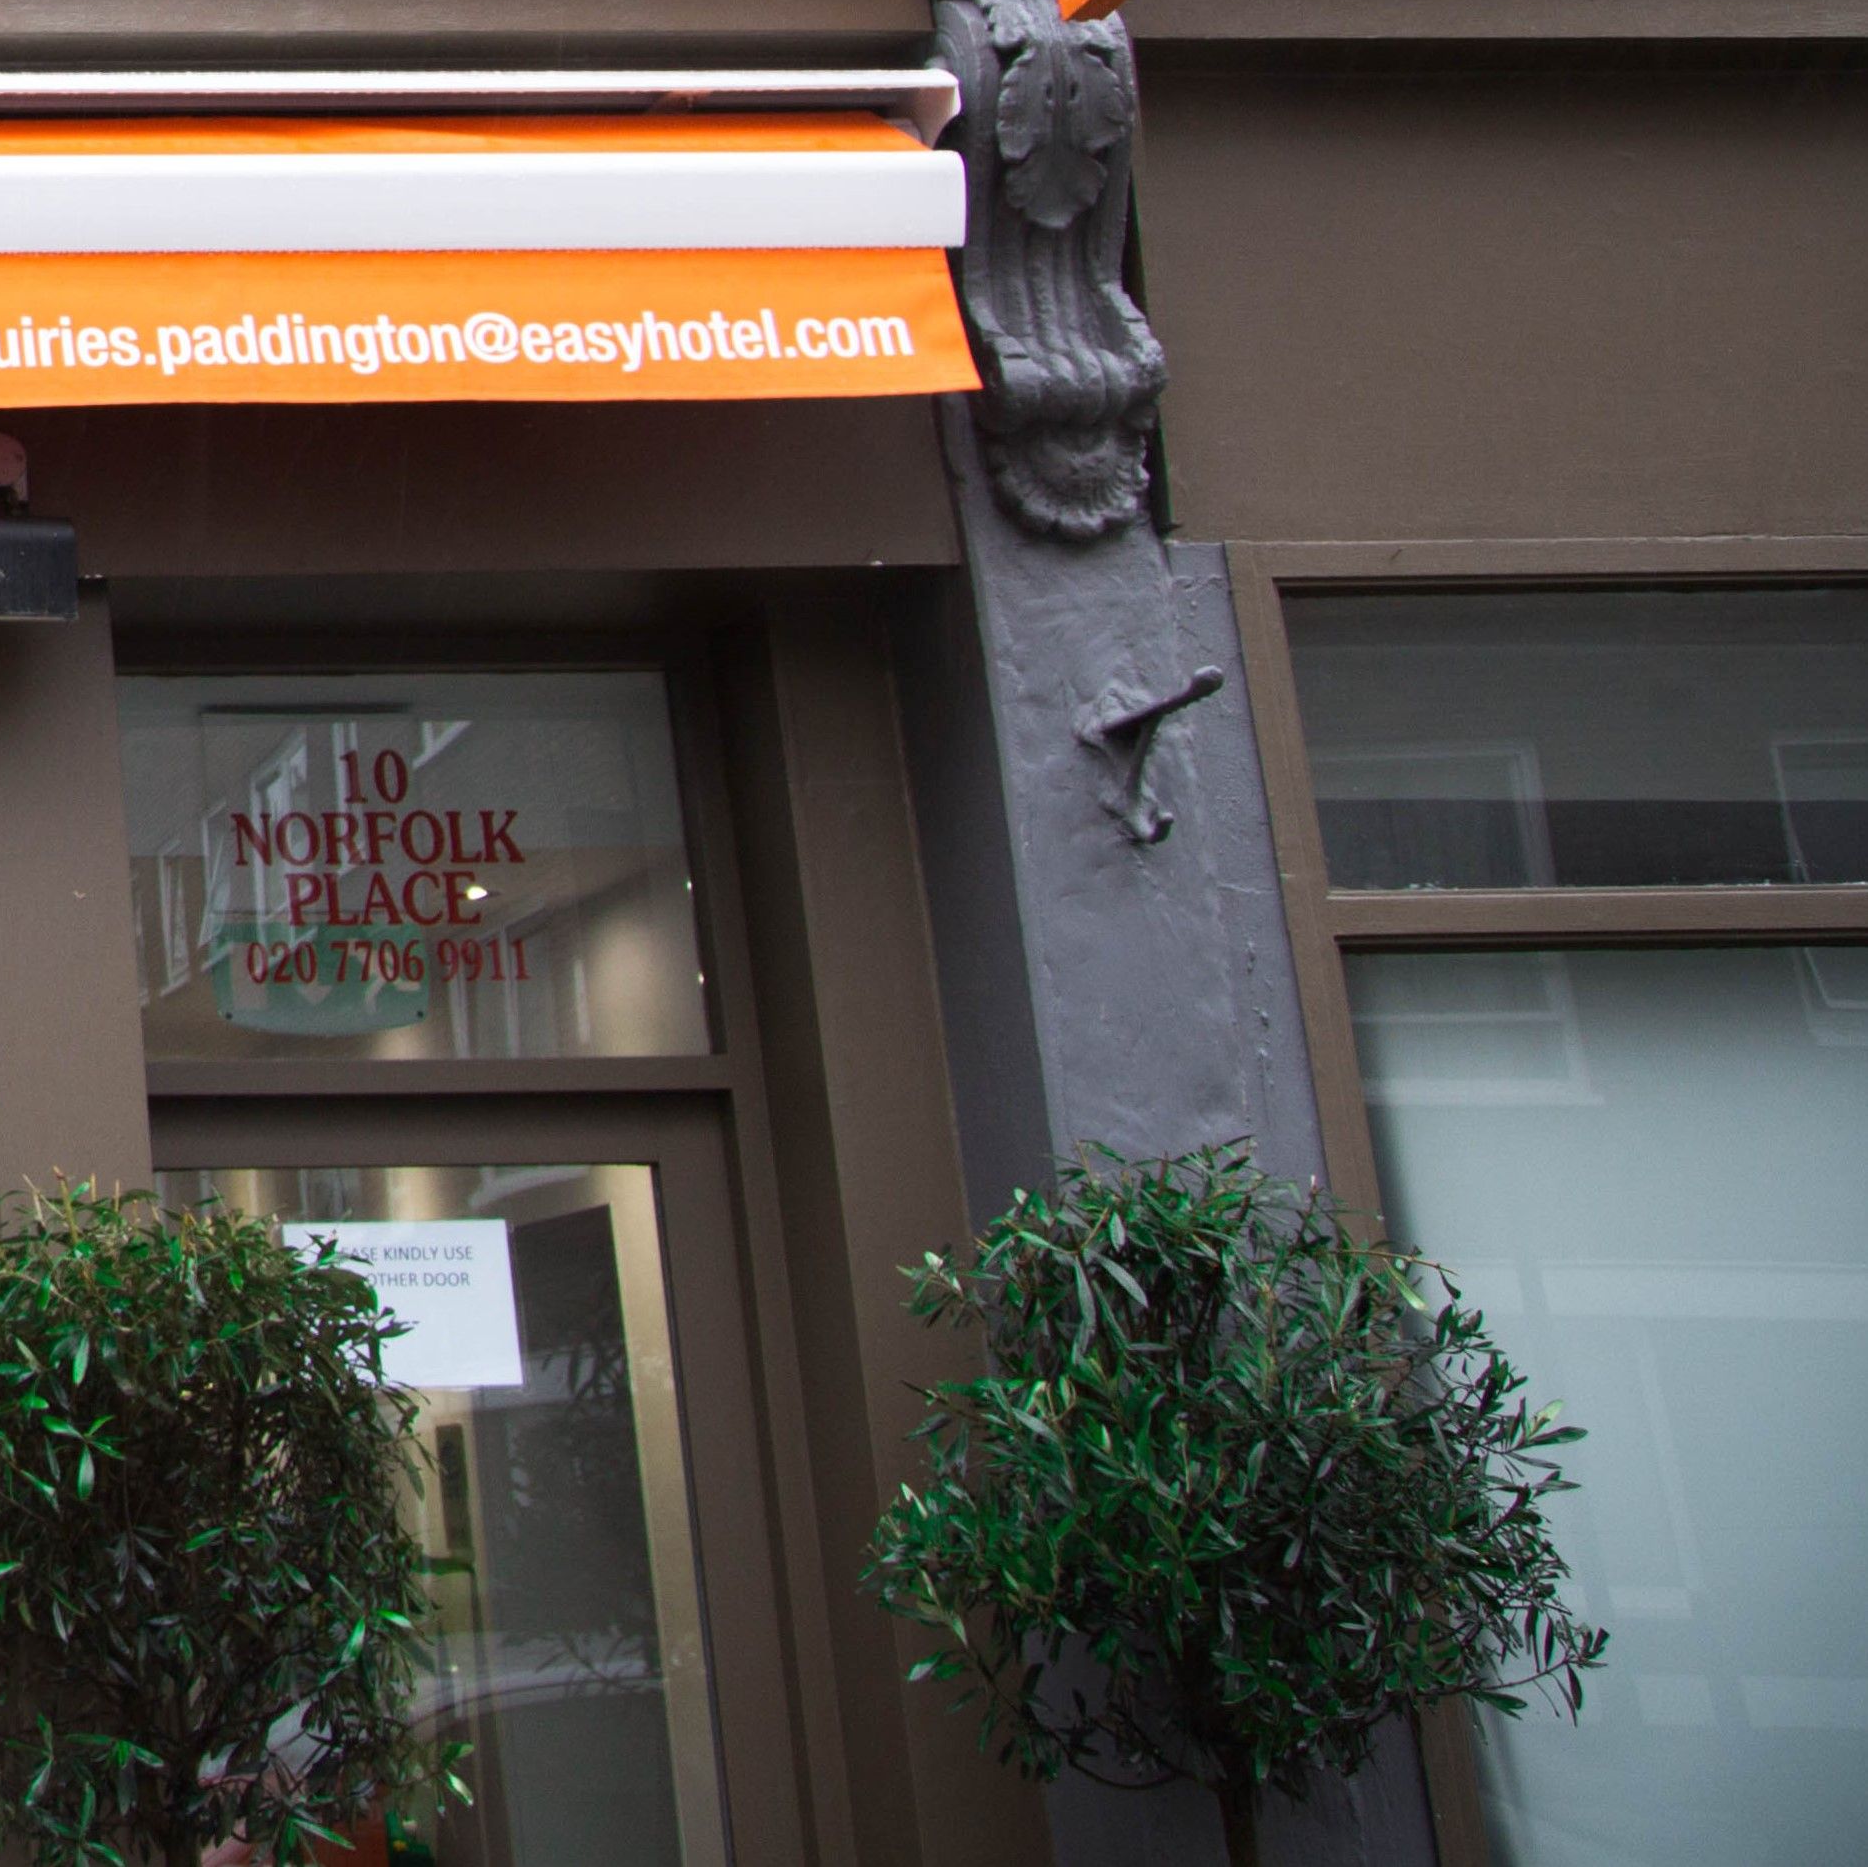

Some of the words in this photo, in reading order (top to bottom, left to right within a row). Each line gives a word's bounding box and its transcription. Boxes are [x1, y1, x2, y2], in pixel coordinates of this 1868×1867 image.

[339, 748, 410, 805] 10
[230, 809, 525, 867] NORFOLK
[284, 870, 482, 927] PLACE
[246, 941, 318, 985] 020
[331, 939, 425, 984] 7706
[437, 938, 531, 983] 9911
[383, 1246, 438, 1261] KINDLY
[443, 1245, 473, 1261] USE
[423, 1272, 471, 1287] DOOR
